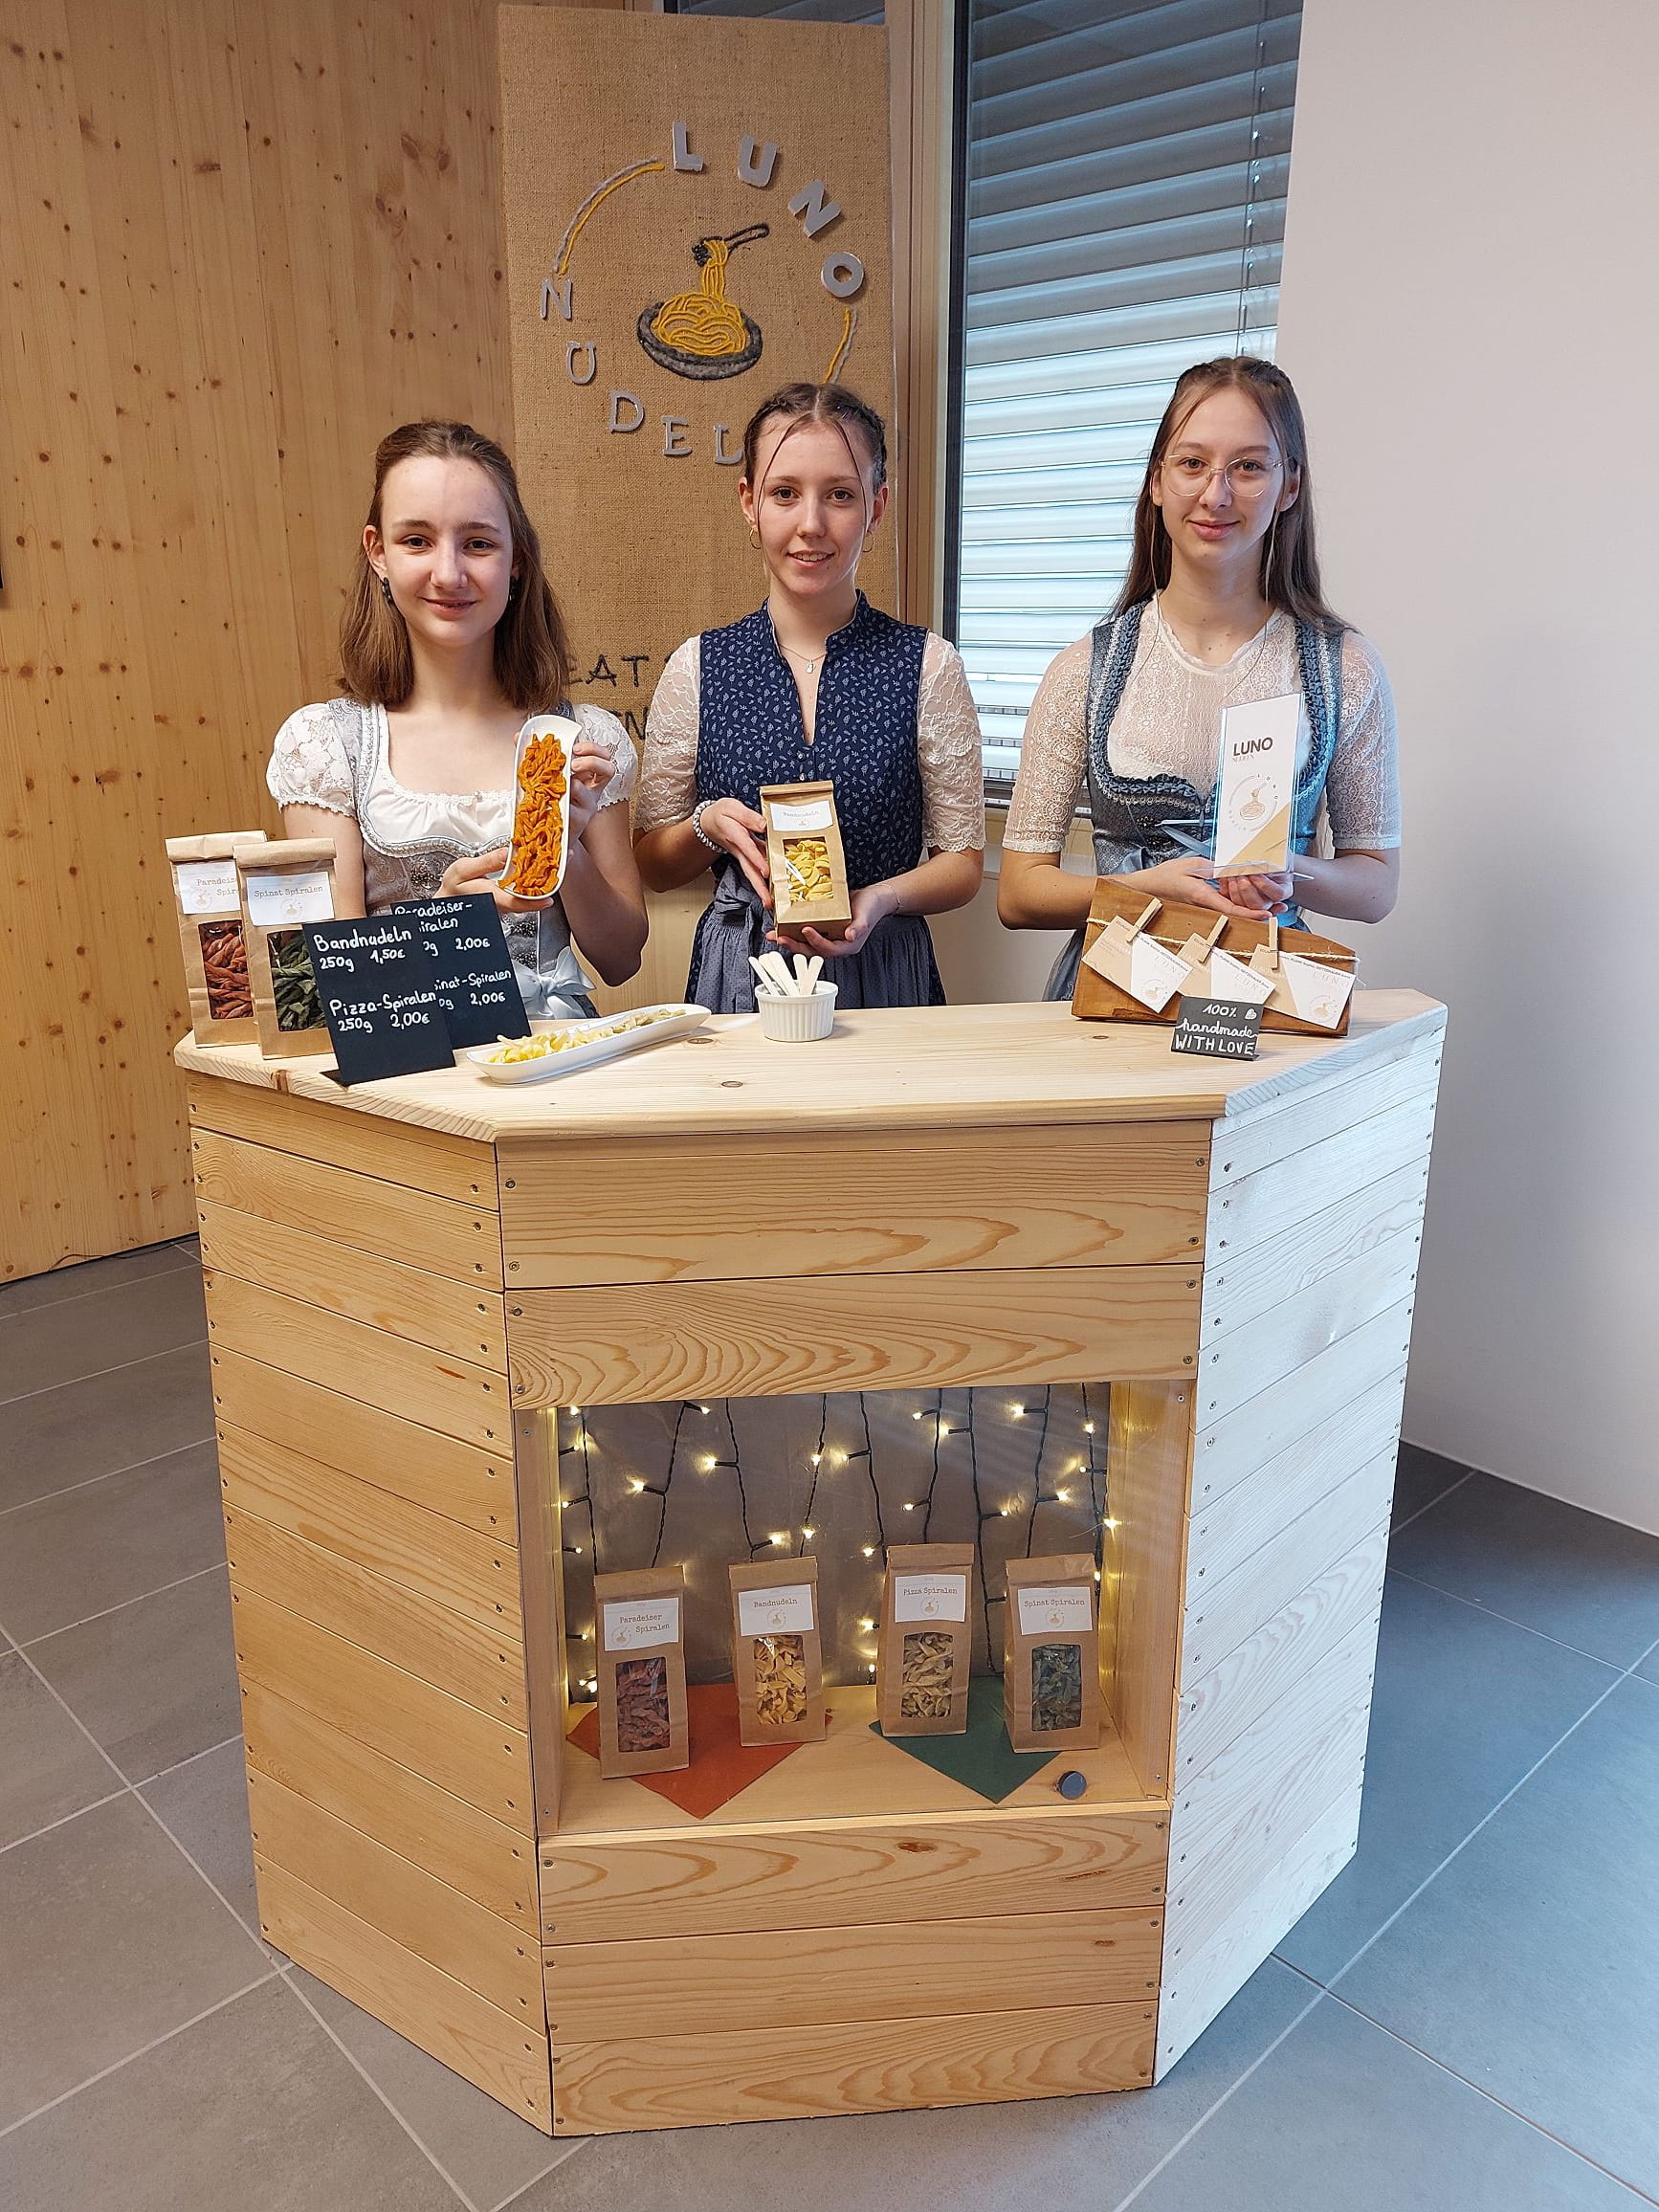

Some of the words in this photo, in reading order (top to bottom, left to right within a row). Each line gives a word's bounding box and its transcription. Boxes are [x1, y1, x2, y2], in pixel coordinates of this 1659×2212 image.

[672, 122, 864, 299] LUNO
[1232, 737, 1273, 757] LUNO
[254, 889, 283, 898] Spinat
[285, 885, 323, 897] Spiralen
[418, 918, 458, 934] iralen
[313, 925, 412, 952] Bandnudeln
[454, 937, 491, 951] 2,00€
[319, 956, 355, 973] 250g
[369, 948, 406, 964] 1,50€
[434, 969, 512, 991] inat-Spiralen
[329, 990, 437, 1017] Pizza-Spiralen
[470, 991, 506, 1006] 2,00€
[1202, 1003, 1237, 1018] 100%
[338, 1017, 373, 1033] 250g
[390, 1011, 431, 1030] 2,00€
[1175, 1017, 1258, 1038] handmade
[1175, 1033, 1215, 1051] WITH
[1218, 1038, 1255, 1056] LOVE
[923, 1586, 958, 1595] Spiralen
[753, 1598, 798, 1608] Bandnudeln
[1024, 1599, 1050, 1607] Spinat
[1051, 1598, 1085, 1607] Spiralen
[619, 1614, 663, 1624] Paradeiser
[635, 1624, 670, 1634] Spiralen
